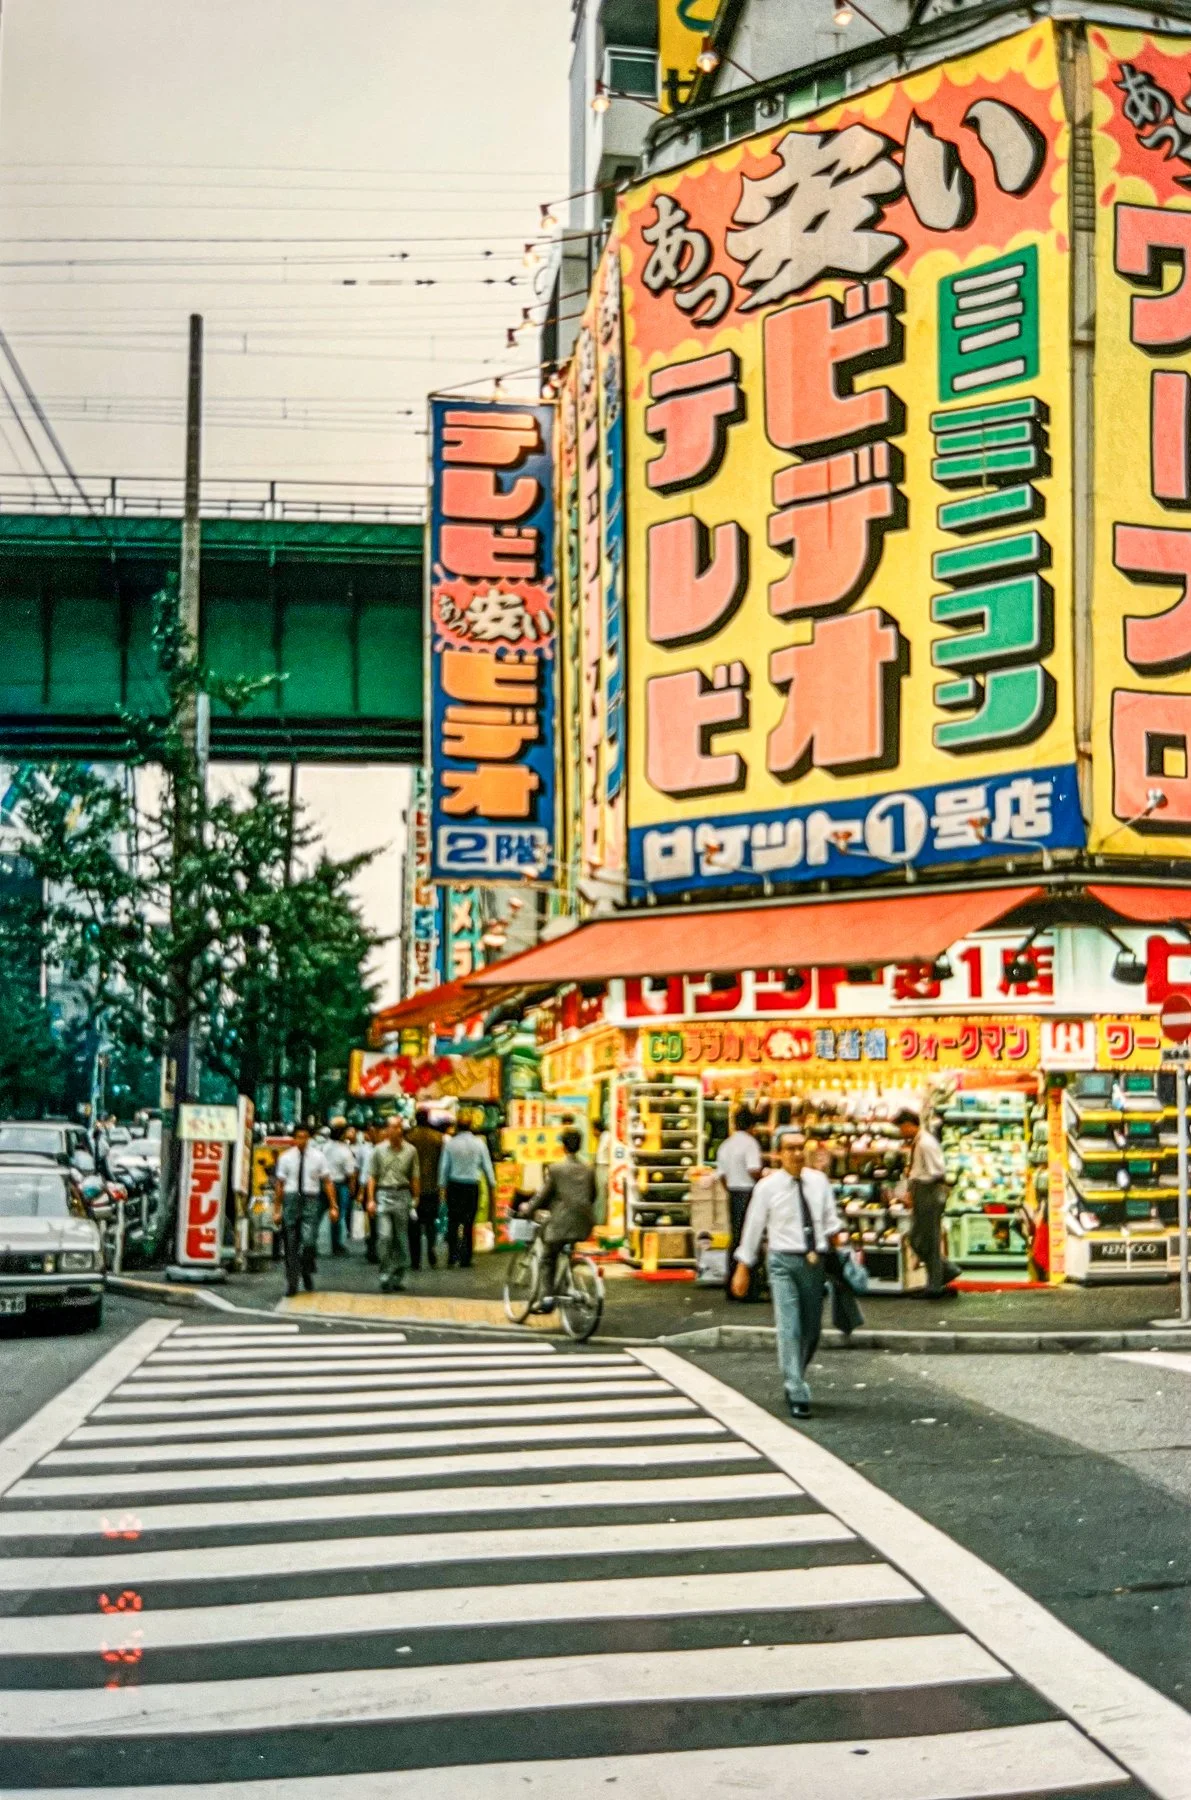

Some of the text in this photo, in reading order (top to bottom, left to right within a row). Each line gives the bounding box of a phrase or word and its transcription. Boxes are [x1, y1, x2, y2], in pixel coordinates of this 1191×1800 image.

[641, 98, 1046, 327] あっ安い
[441, 410, 544, 578] テレビ
[645, 349, 752, 801] テレビ
[764, 277, 909, 787] ビデオ
[440, 650, 546, 820] ビデオ
[186, 1162, 221, 1260] テレビ
[192, 1141, 223, 1160] BS
